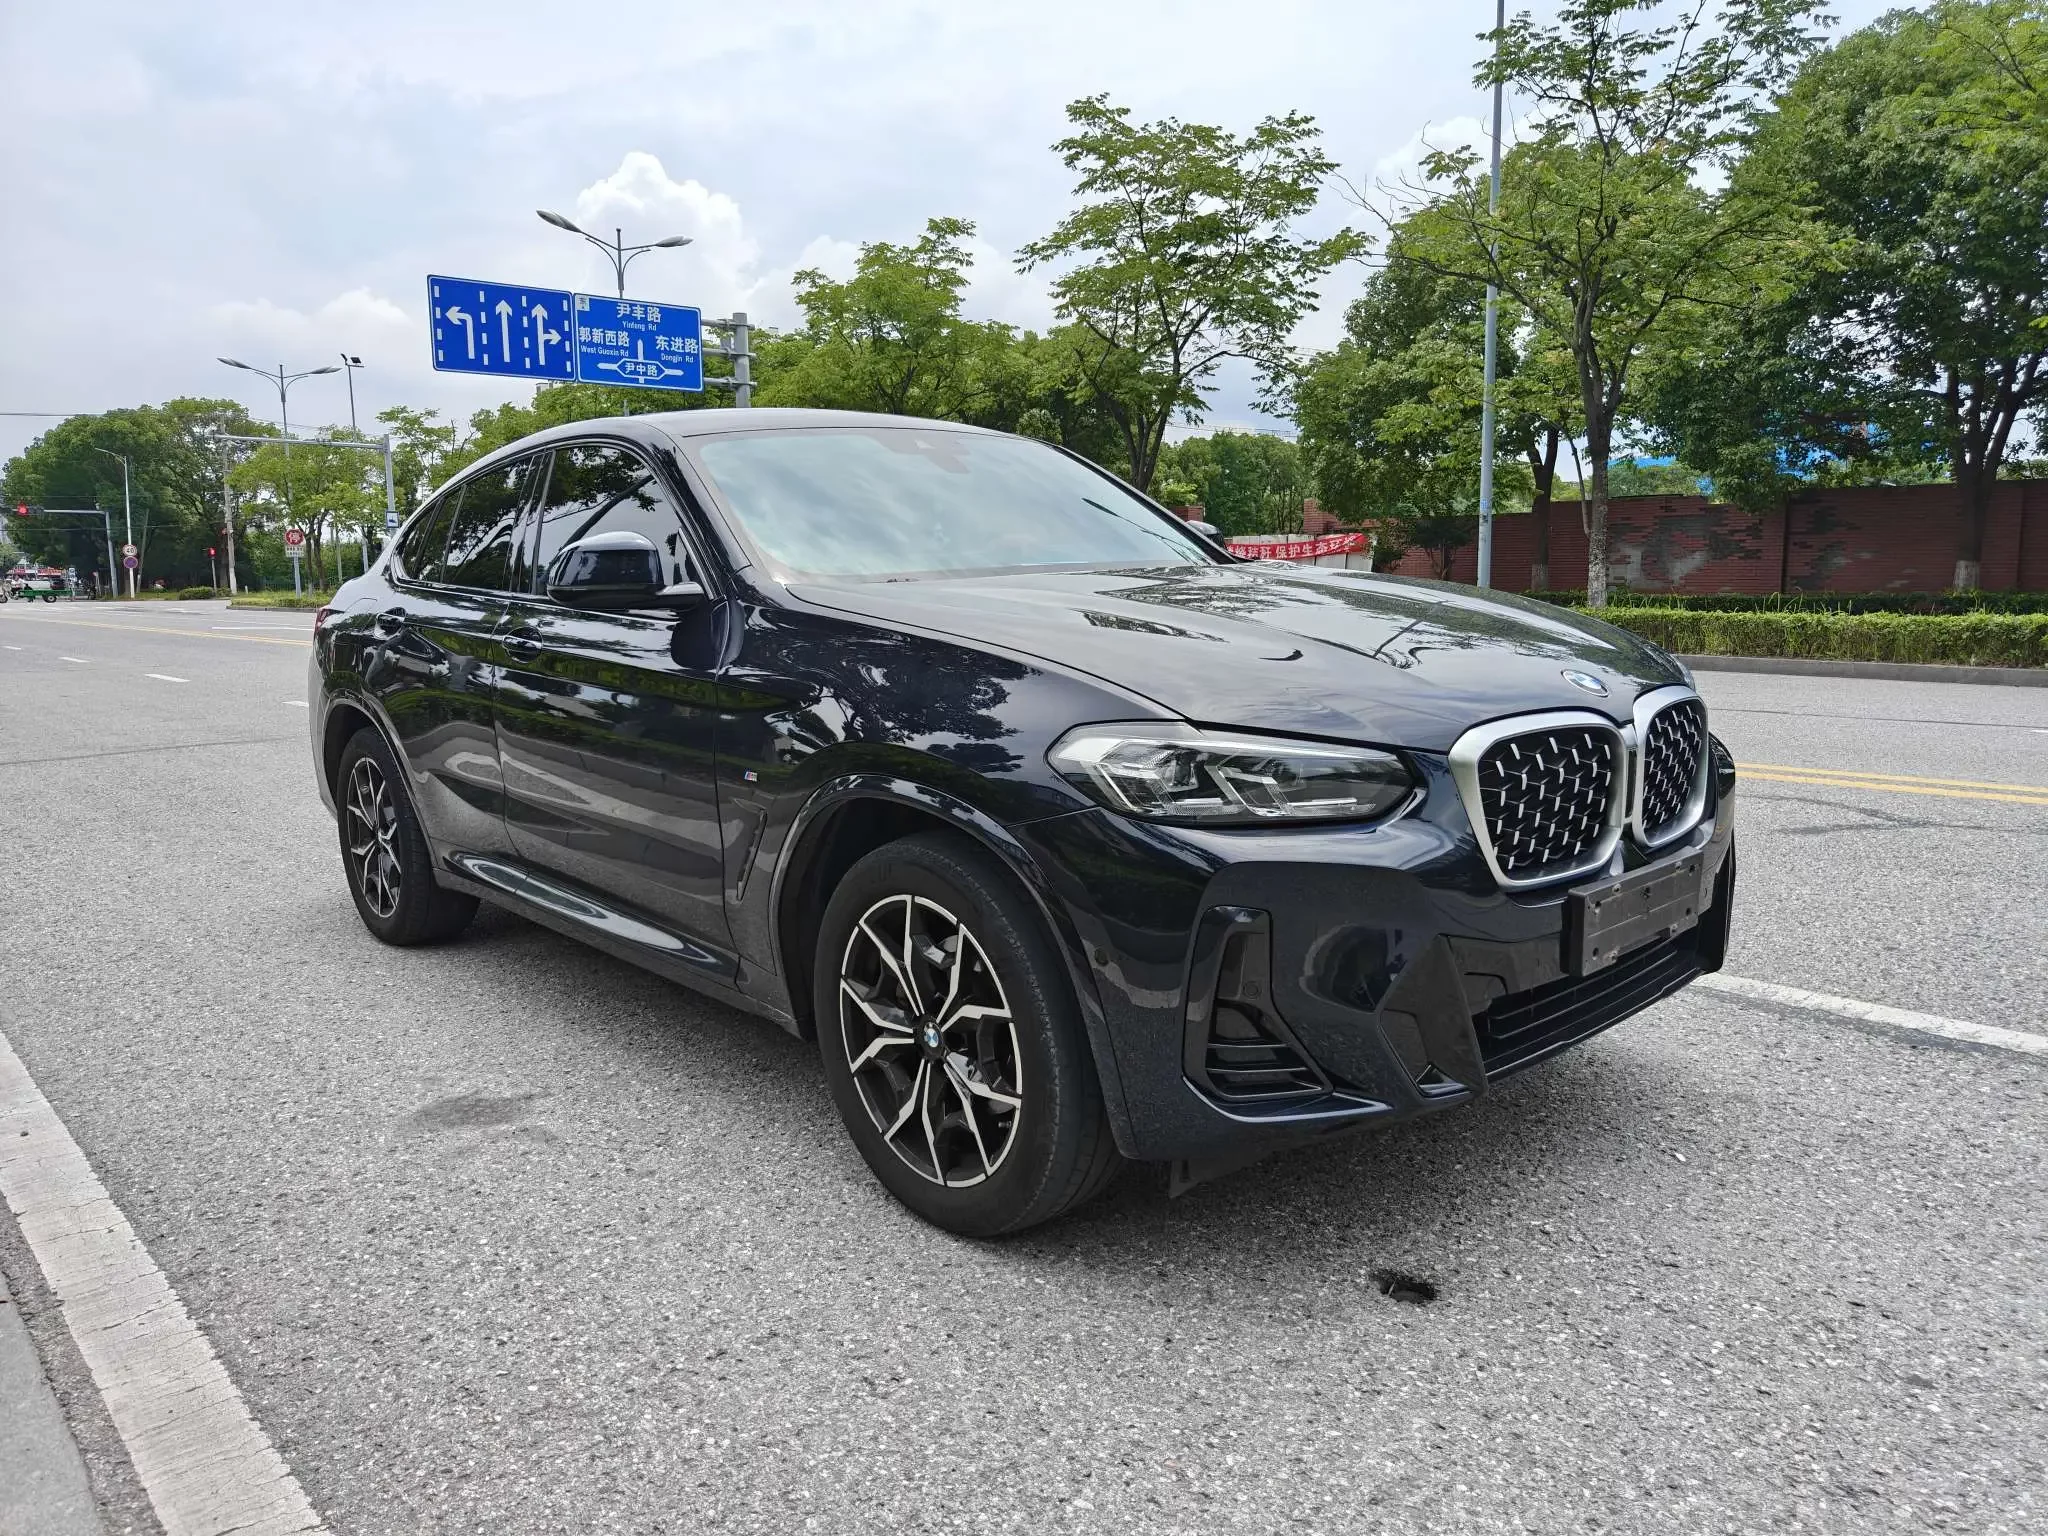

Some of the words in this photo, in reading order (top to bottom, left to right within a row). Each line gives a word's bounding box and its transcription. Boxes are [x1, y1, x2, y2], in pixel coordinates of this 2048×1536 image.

[616, 302, 662, 323] 尹丰路
[648, 323, 657, 331] Rd
[578, 326, 630, 347] 郭新西路
[655, 335, 699, 354] 东进路
[620, 349, 629, 357] Rd
[685, 355, 694, 363] Rd
[625, 362, 658, 377] 尹中路
